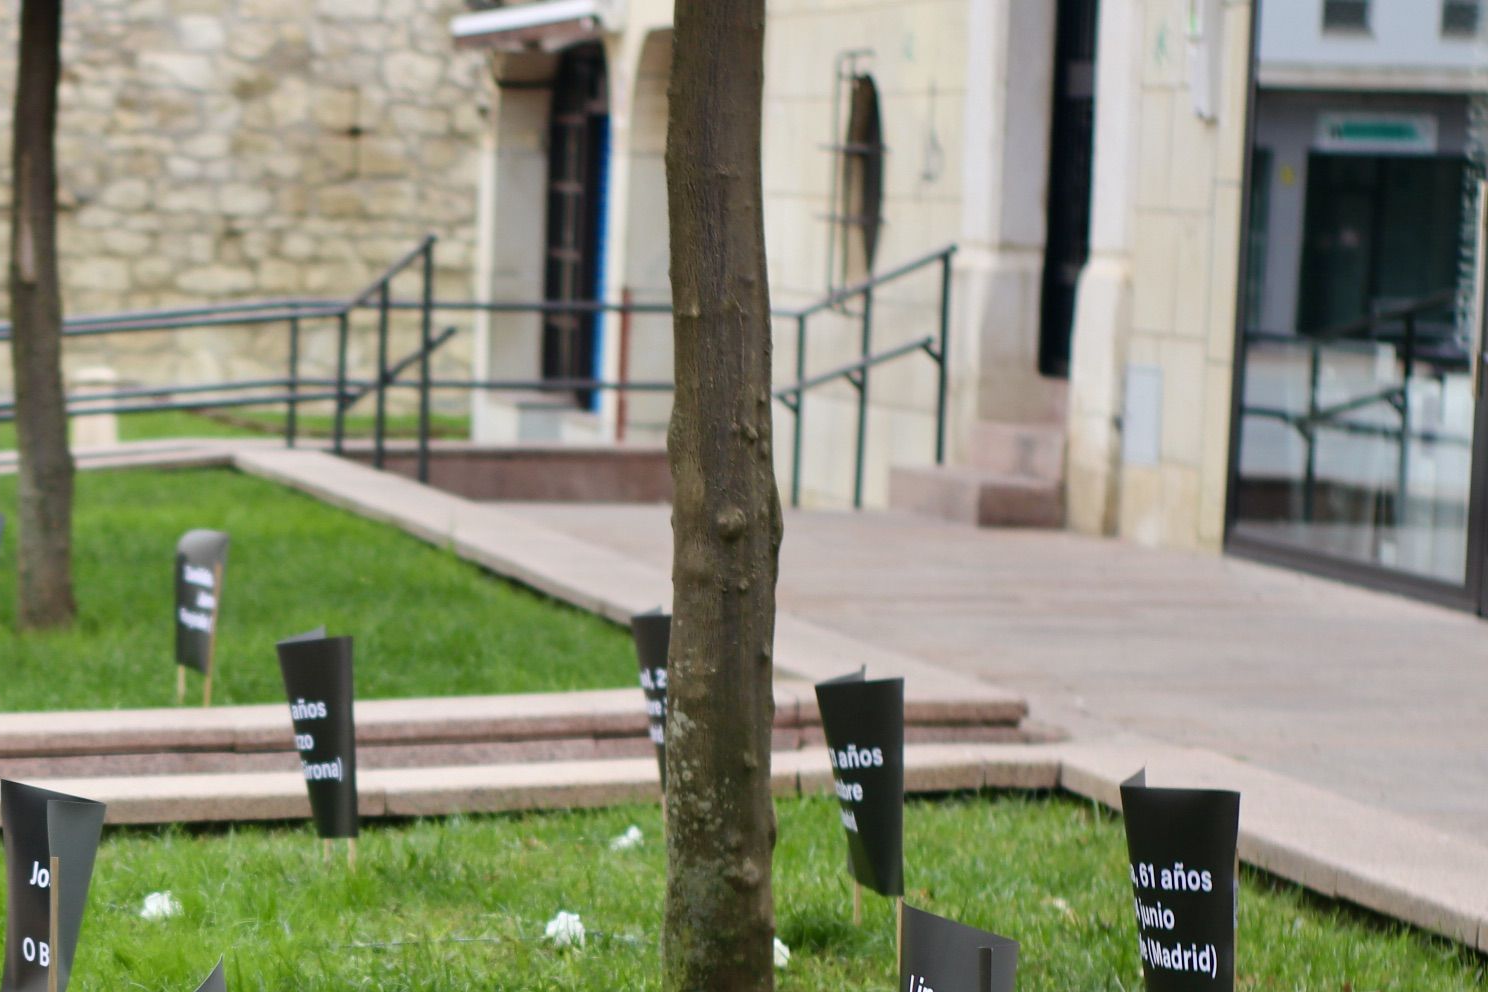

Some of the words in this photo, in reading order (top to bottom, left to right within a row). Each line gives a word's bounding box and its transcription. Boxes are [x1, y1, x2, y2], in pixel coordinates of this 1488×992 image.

[838, 743, 884, 769] años
[30, 861, 50, 888] Jo
[1139, 862, 1156, 890] 61
[1160, 861, 1213, 892] años
[1147, 936, 1218, 980] (Madrid)
